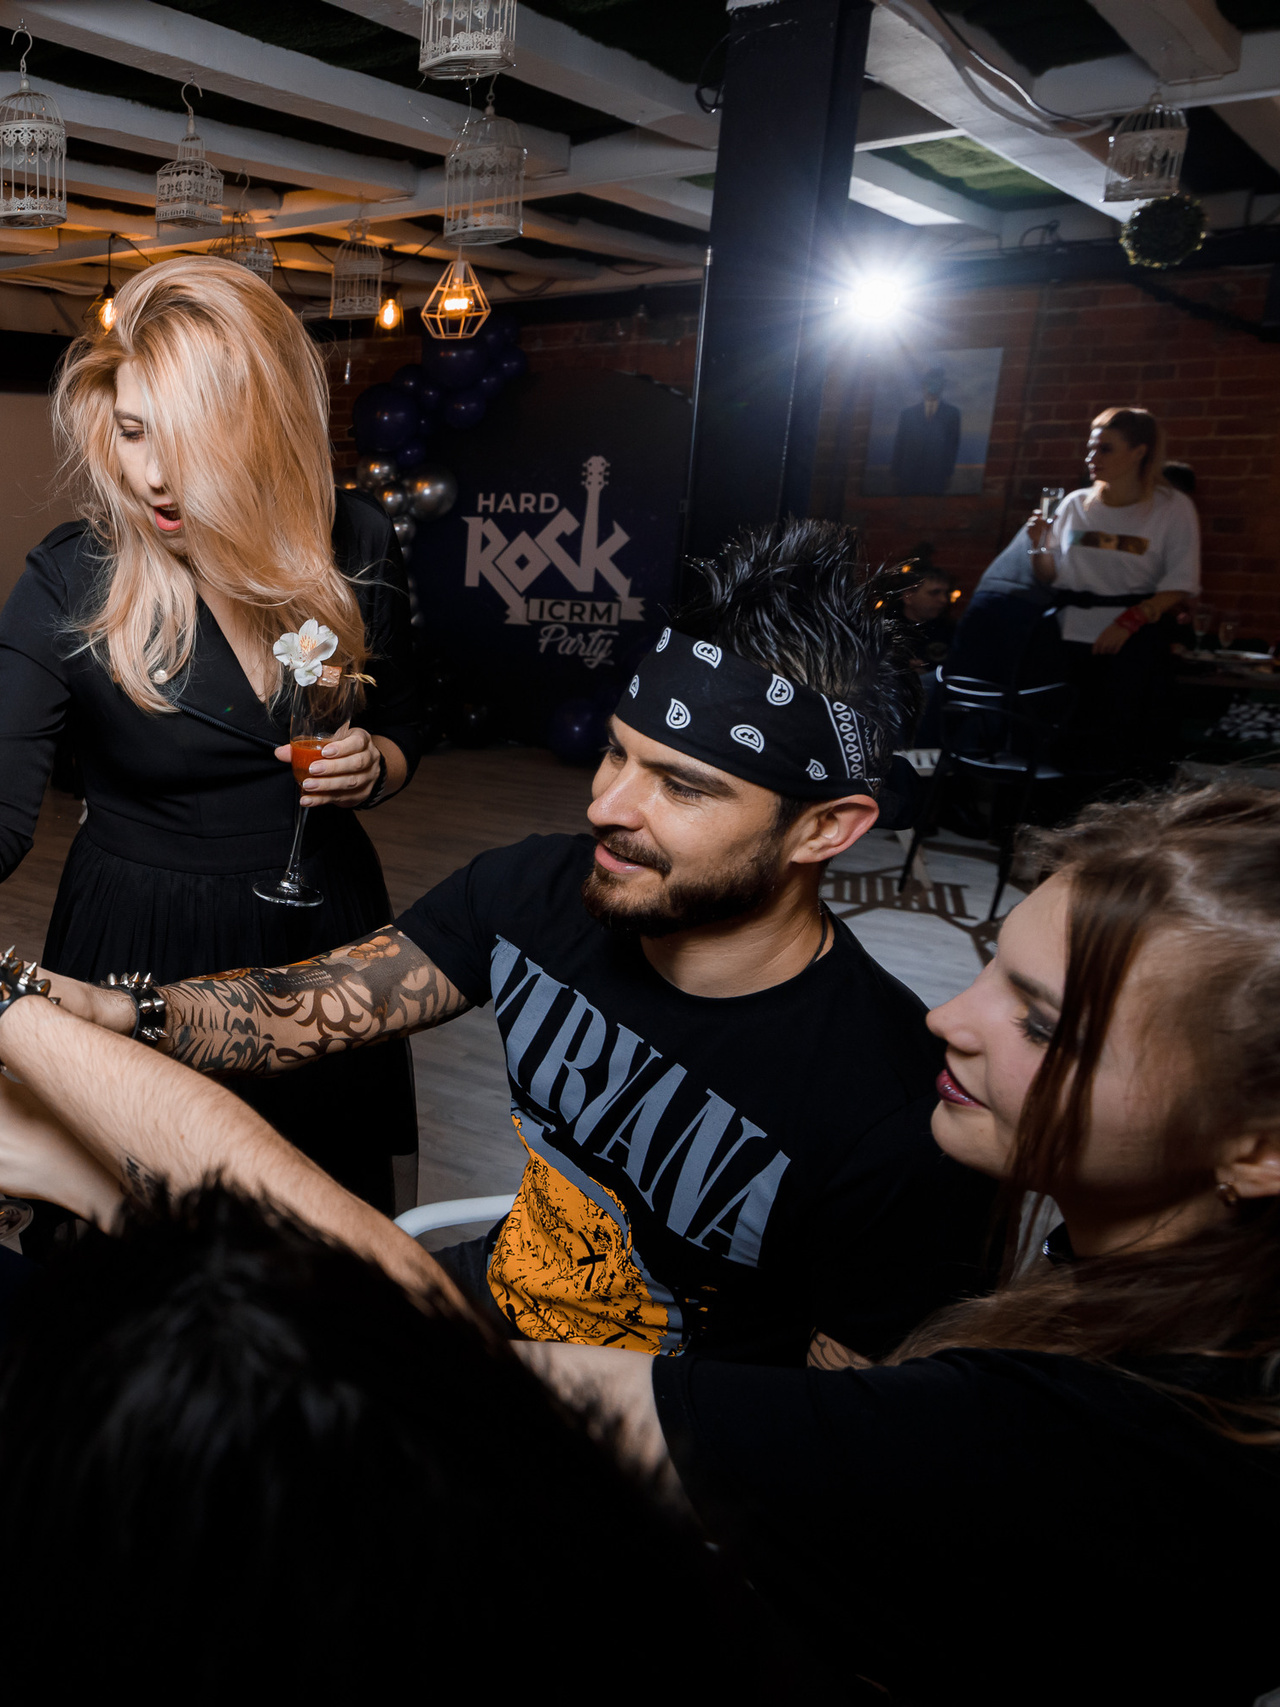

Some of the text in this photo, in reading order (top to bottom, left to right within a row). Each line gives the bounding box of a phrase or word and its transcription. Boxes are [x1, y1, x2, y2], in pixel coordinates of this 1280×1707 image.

[477, 492, 560, 513] HARD
[539, 600, 613, 623] ICRM
[538, 623, 619, 669] Party
